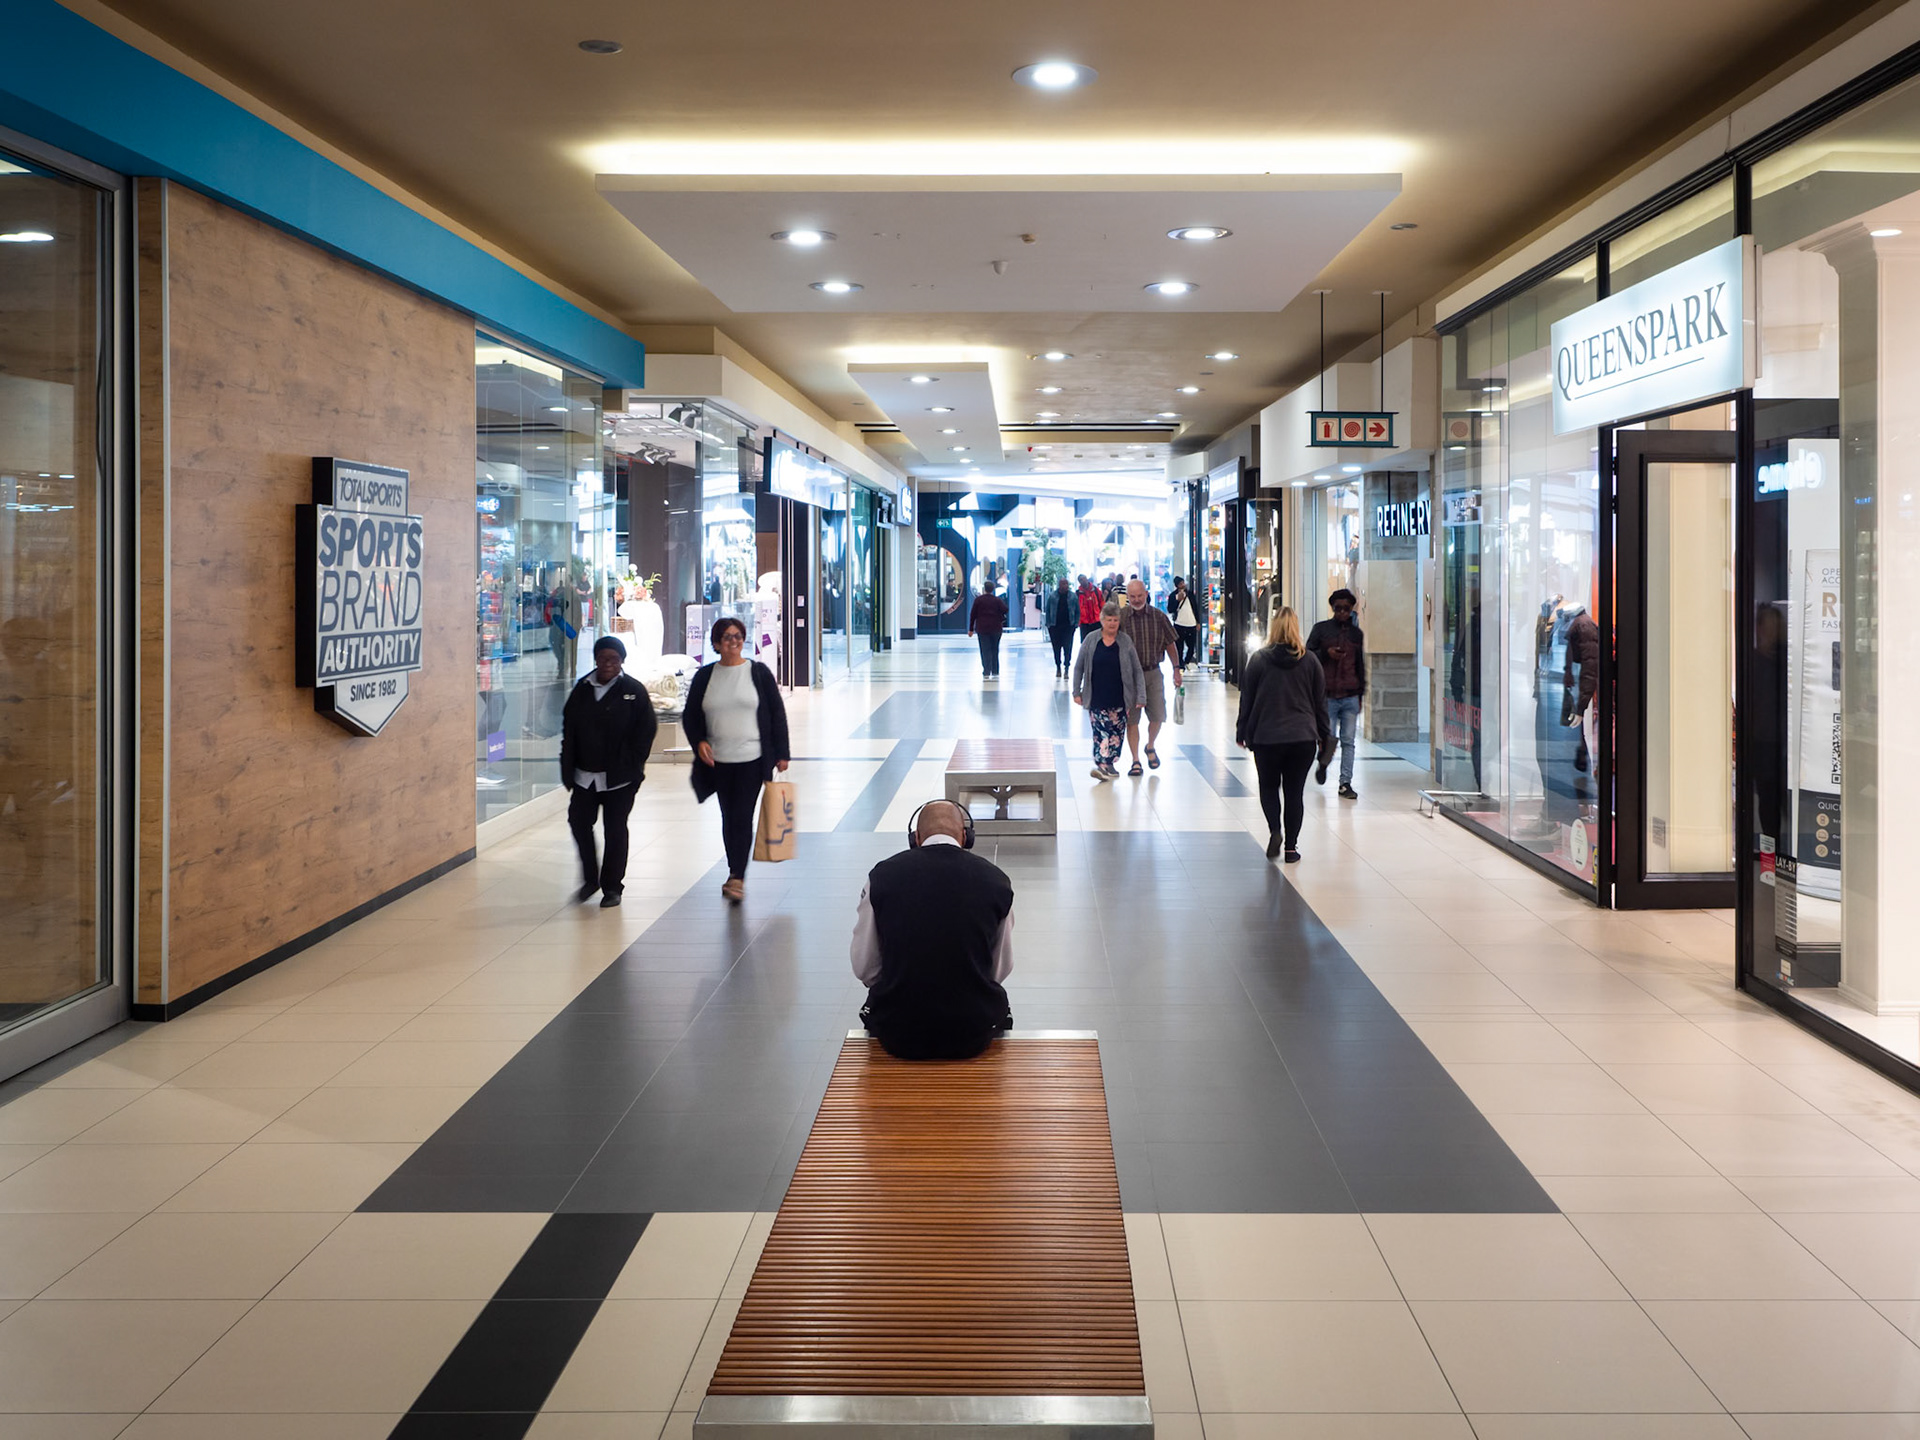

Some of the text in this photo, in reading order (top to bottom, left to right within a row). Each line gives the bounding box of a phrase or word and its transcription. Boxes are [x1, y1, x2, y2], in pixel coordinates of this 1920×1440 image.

[1558, 281, 1728, 401] QUEENSPARK
[340, 477, 402, 508] TOTALSPORTS
[1377, 500, 1431, 537] REFINERY
[319, 515, 423, 569] SPORTS
[318, 570, 422, 633] BRAND
[321, 632, 420, 673] AUTHORITY
[350, 679, 397, 702] SINCE 1982
[1775, 855, 1796, 872] LAY-BY
